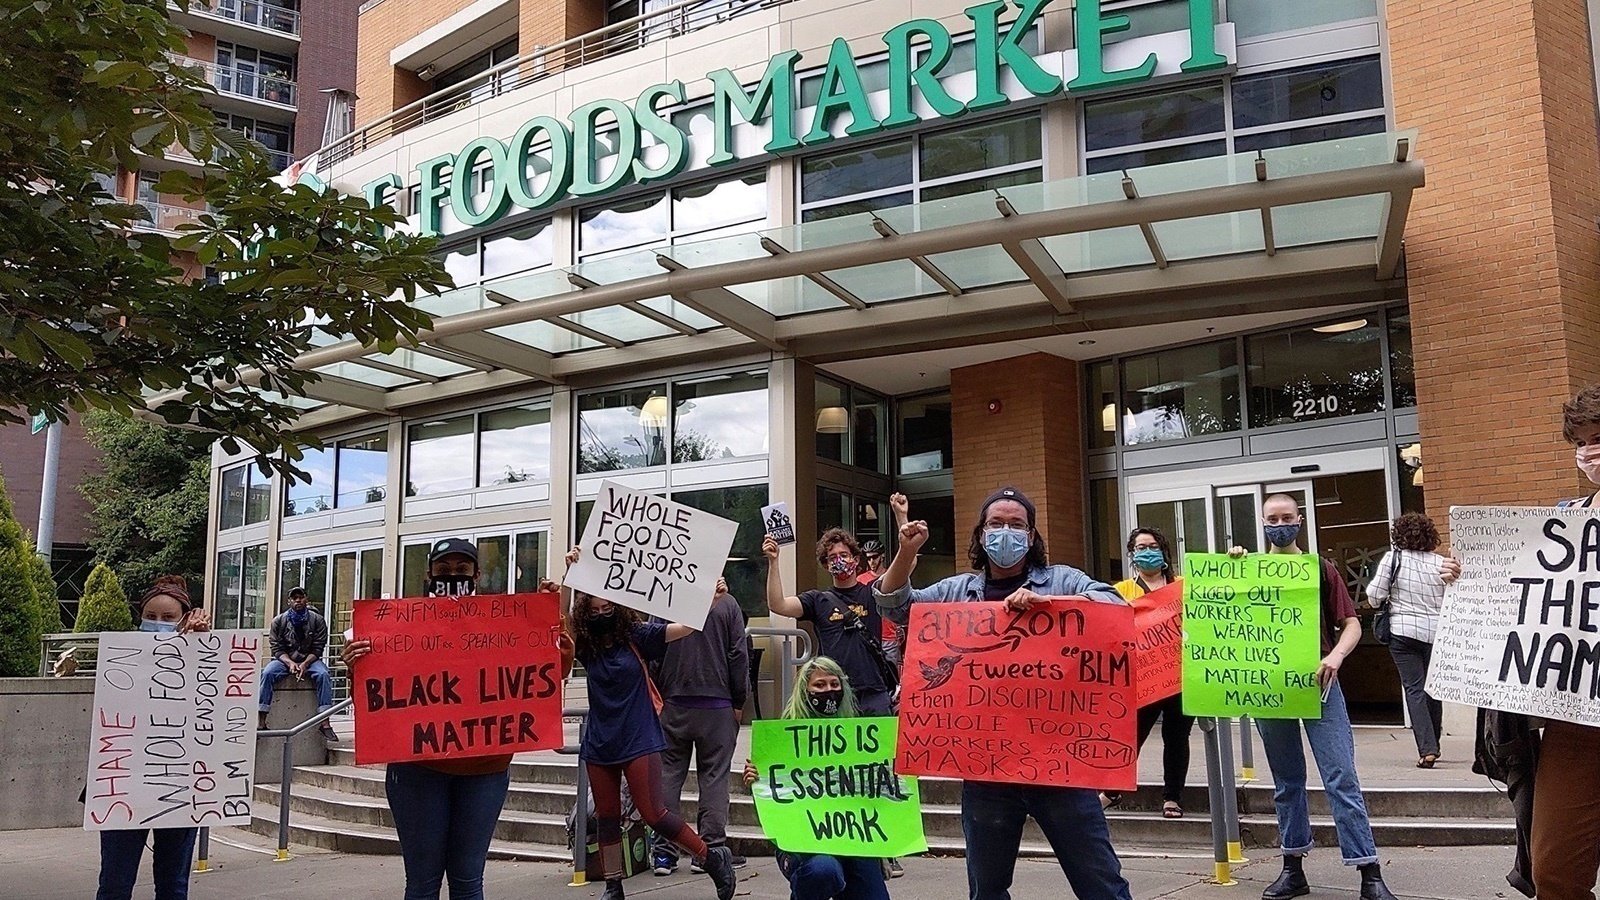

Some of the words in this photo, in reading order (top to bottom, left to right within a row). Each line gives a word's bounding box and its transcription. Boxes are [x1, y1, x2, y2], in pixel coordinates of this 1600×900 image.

[416, 79, 690, 240] FOODS
[706, 0, 1228, 167] MARKET
[1293, 395, 1338, 416] 2210
[608, 487, 692, 533] WHOLE
[1451, 507, 1487, 520] George
[1489, 507, 1511, 520] Floyd
[598, 511, 691, 556] FOODS
[1456, 523, 1492, 538] Breonna
[1491, 522, 1515, 537] Taylor
[593, 540, 698, 584] CENSORS
[1190, 559, 1247, 579] WHOLE
[1257, 560, 1310, 581] FOODS
[1460, 568, 1482, 580] andra
[1484, 568, 1508, 580] Bland
[1488, 554, 1511, 567] Wilson
[435, 580, 470, 597] BLM
[604, 563, 673, 608] BLM
[1248, 585, 1285, 603] OUT
[491, 600, 528, 619] BLM
[1185, 604, 1253, 622] WORKERS
[1271, 606, 1303, 626] FOR
[1510, 577, 1600, 633] THE
[421, 635, 443, 651] OUT
[460, 632, 521, 651] SPEAKING
[527, 629, 559, 648] OUT
[917, 606, 1085, 643] amazon
[1213, 622, 1284, 644] WEARING
[104, 646, 142, 690] ON
[149, 634, 189, 701] FOODS
[225, 634, 258, 698] PRIDE
[962, 659, 1064, 681] tweets
[1245, 646, 1280, 665] LIVES
[1497, 630, 1600, 700] NAM
[194, 633, 222, 747] CENSORING
[366, 670, 462, 712] BLACK
[479, 662, 556, 704] LIVES
[1284, 670, 1316, 690] FACE
[908, 691, 954, 709] then
[967, 685, 1128, 719] DISCIPLINES
[1225, 690, 1284, 708] MASKS!
[1531, 696, 1559, 707] RICE
[1538, 705, 1568, 718] GRAY
[225, 706, 248, 745] AND
[413, 712, 540, 755] MATTER
[785, 724, 847, 758] THIS
[856, 724, 879, 753] IS
[905, 711, 1008, 732] WHOLE
[1026, 717, 1112, 740] FOODS
[903, 732, 1031, 755] WORKERS
[1043, 743, 1065, 755] for
[90, 707, 136, 825] SHAME
[139, 714, 191, 825] WHOLE
[769, 759, 911, 804] ESSENTIAL
[191, 760, 222, 825] STOP
[222, 759, 251, 818] BLM
[806, 807, 888, 843] WORK
